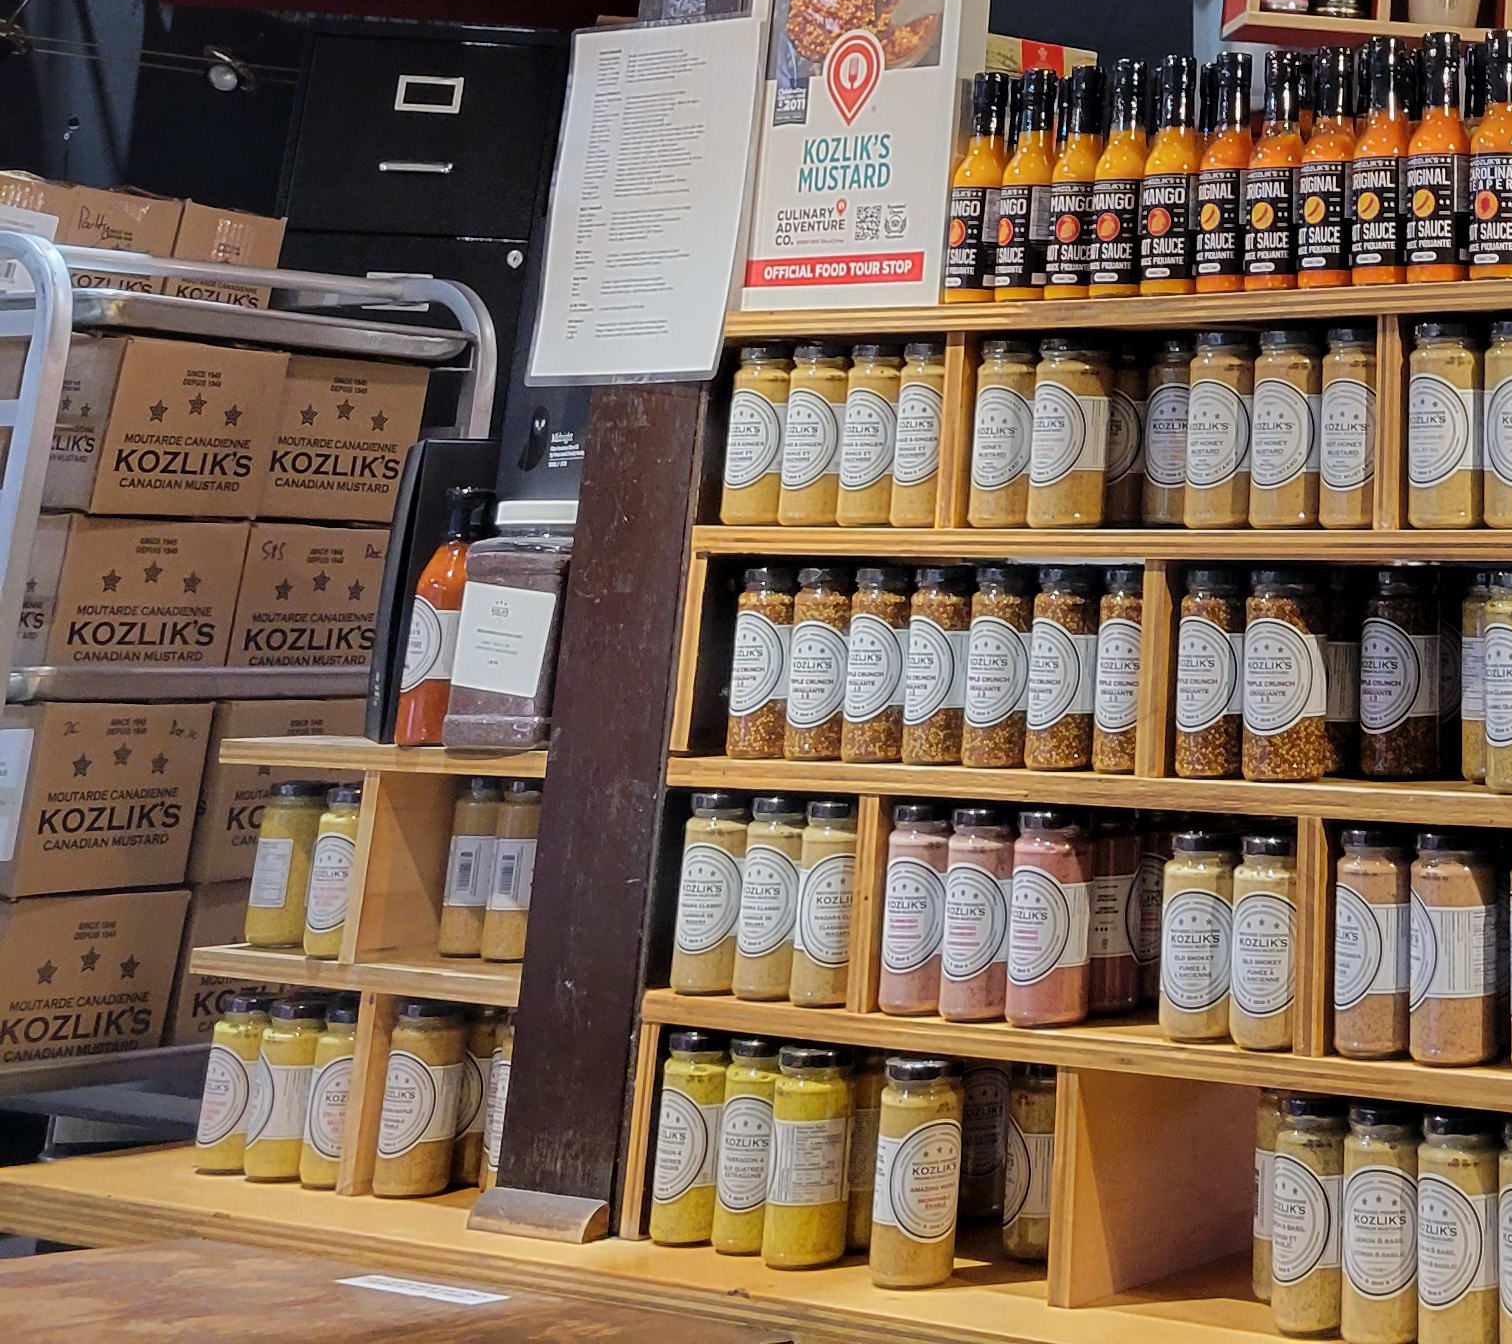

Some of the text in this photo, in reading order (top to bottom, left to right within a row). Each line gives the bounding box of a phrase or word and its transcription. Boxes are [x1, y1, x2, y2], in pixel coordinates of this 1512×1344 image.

[784, 99, 805, 110] 2011
[803, 134, 891, 164] KOZLIK'S
[798, 163, 891, 193] MUSTARD
[1093, 194, 1134, 210] MANGO
[1143, 188, 1186, 205] MANGO
[777, 208, 834, 221] CULINARY
[776, 219, 845, 233] ADVENTURE
[1362, 223, 1396, 240] SAUCE
[1418, 220, 1452, 237] SAUCE
[775, 235, 794, 246] CO.
[1204, 233, 1236, 249] SAUCE
[1257, 232, 1289, 249] SAUCE
[1308, 226, 1341, 244] SAUCE
[1101, 243, 1133, 259] SAUCE
[1153, 238, 1185, 254] SAUCE
[764, 260, 912, 280] OFFICIAL FOOD TOUR STOP
[124, 433, 251, 450] MOUTARDE CANADIENNE
[278, 436, 398, 453] MOUTARDE CANADIENNE
[113, 449, 253, 477] KOZLIK'S
[269, 450, 400, 480] KOZLIK'S
[119, 478, 240, 492] CANADIAN MUSTARD
[275, 479, 389, 494] CANADIAN MUSTARD
[77, 605, 212, 617] MOUTARDE CANADIENNE
[252, 612, 375, 623] MOUTARDE CANADIENNE
[67, 619, 216, 646] KOZLIK'S
[243, 626, 375, 651] KOZLIK'S
[73, 650, 203, 662] CANADIAN MUSTARD
[249, 654, 366, 666] CANADIAN MUSTARD
[47, 787, 179, 803] MOUTARDE CANADIENNE
[38, 804, 182, 834] KOZLIK'S
[43, 833, 169, 852] CANADIAN MUSTARD
[0, 1007, 152, 1046] KOZLIK'S
